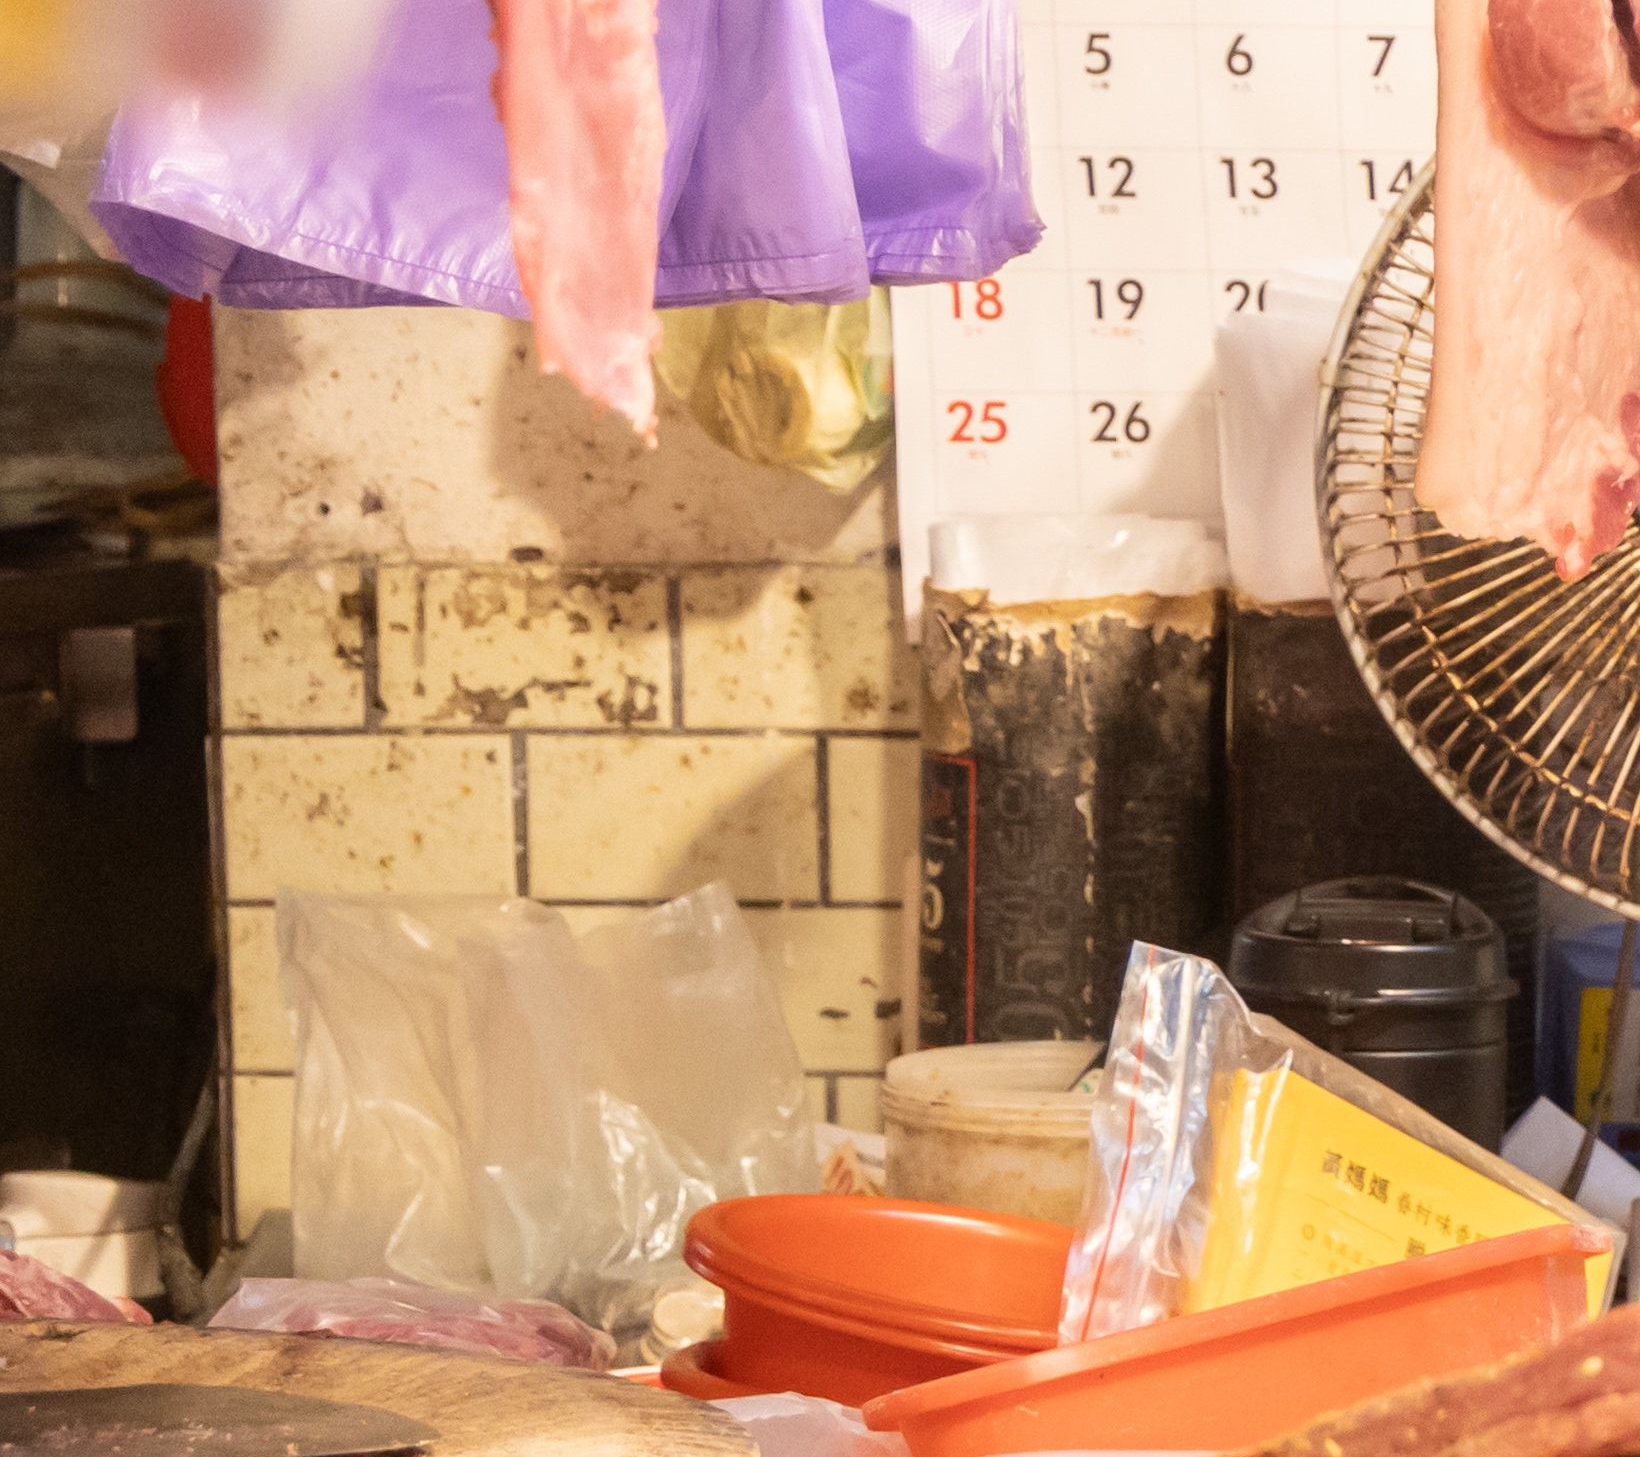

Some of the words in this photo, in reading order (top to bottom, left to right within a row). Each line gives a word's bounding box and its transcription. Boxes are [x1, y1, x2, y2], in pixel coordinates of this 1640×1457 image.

[1083, 32, 1112, 75] 5
[1225, 33, 1254, 77] 6
[1366, 34, 1397, 78] 7
[1077, 154, 1138, 199] 12
[1219, 156, 1279, 200] 13
[1358, 158, 1415, 201] 14
[945, 277, 1005, 321] 18
[1086, 277, 1146, 321] 19
[946, 400, 1009, 444] 25
[1089, 400, 1152, 444] 26
